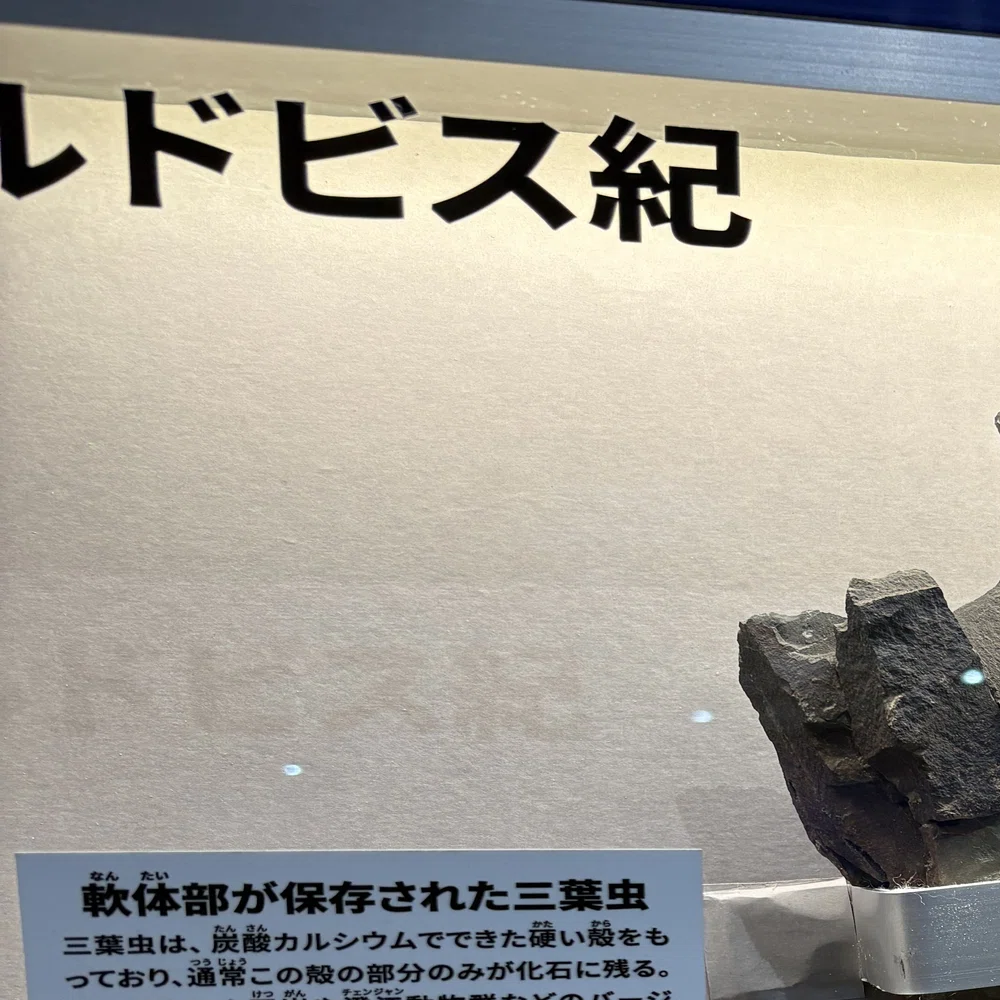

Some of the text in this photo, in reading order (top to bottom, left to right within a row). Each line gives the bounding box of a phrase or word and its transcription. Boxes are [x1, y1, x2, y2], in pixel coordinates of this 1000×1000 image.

[82, 879, 650, 918] 軟体部が保存された三葉虫
[63, 927, 670, 956] 三葉虫は、炭酸カルシウムでできた硬い殻をも
[65, 960, 670, 990] っており、通常この殻の部分のみが化石に残る。
